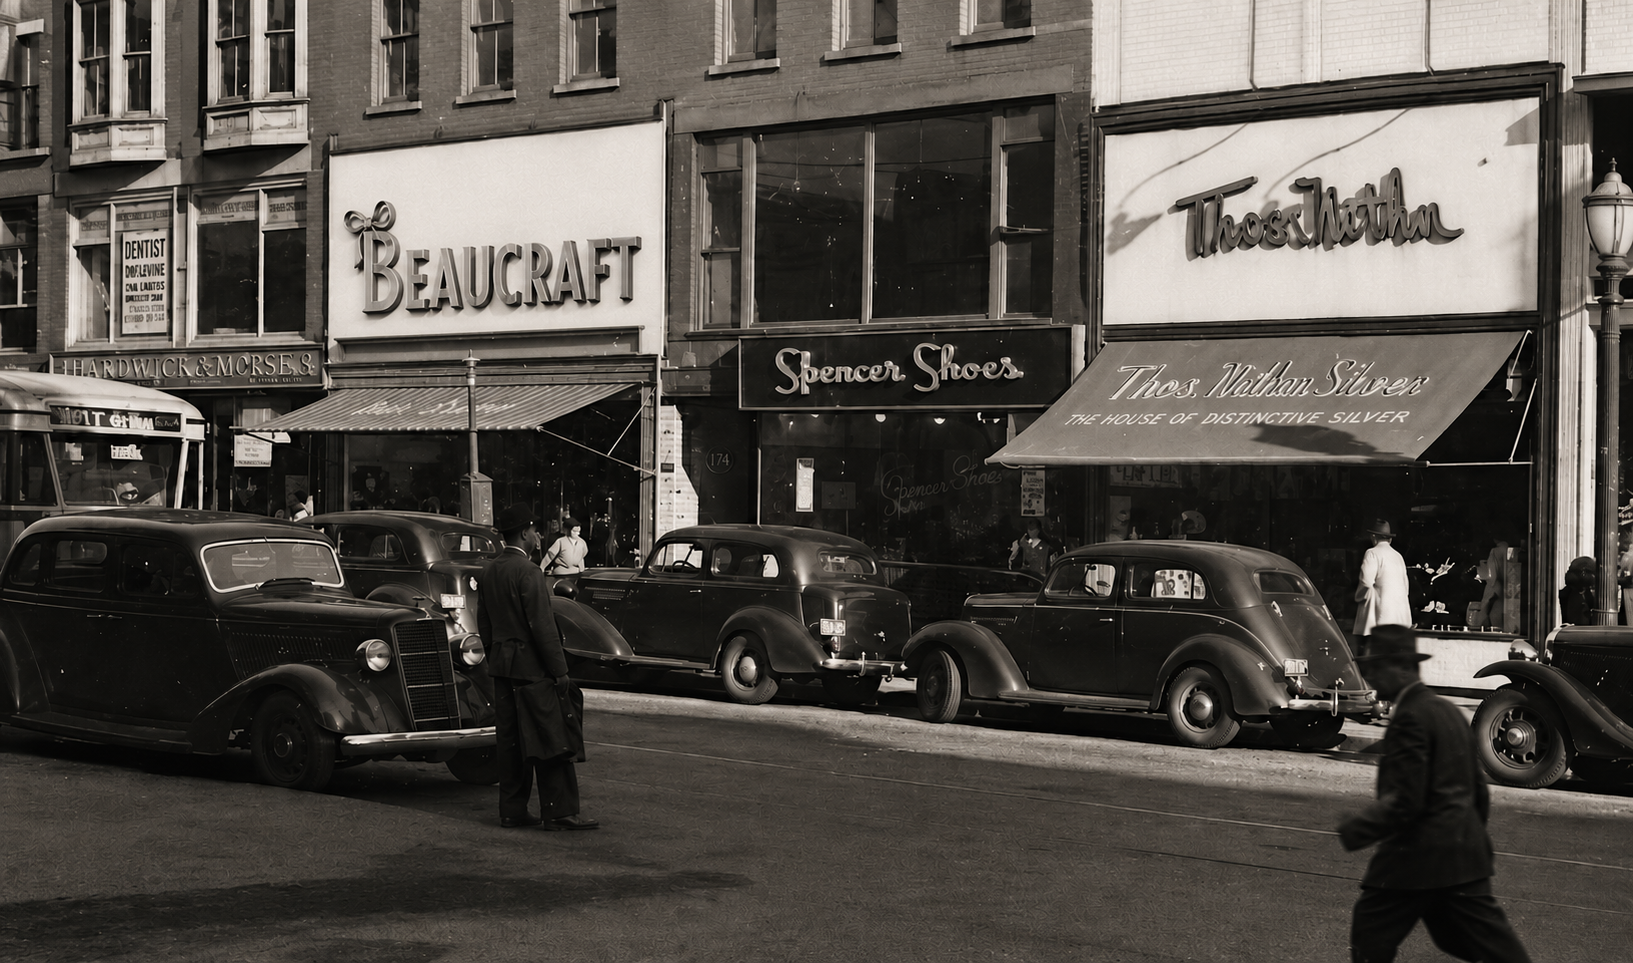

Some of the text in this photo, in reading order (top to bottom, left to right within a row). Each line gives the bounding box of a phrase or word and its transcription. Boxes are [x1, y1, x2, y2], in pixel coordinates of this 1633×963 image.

[125, 238, 166, 260] DENTIST
[360, 228, 643, 316] BEAUCRAFT
[774, 342, 1024, 395] Spencer Shoes
[1203, 360, 1315, 398] Nathan
[1312, 358, 1430, 397] Silver
[1064, 409, 1411, 426] THE HOUSE OF DISTINCTIVE SILVER
[711, 453, 730, 466] 174
